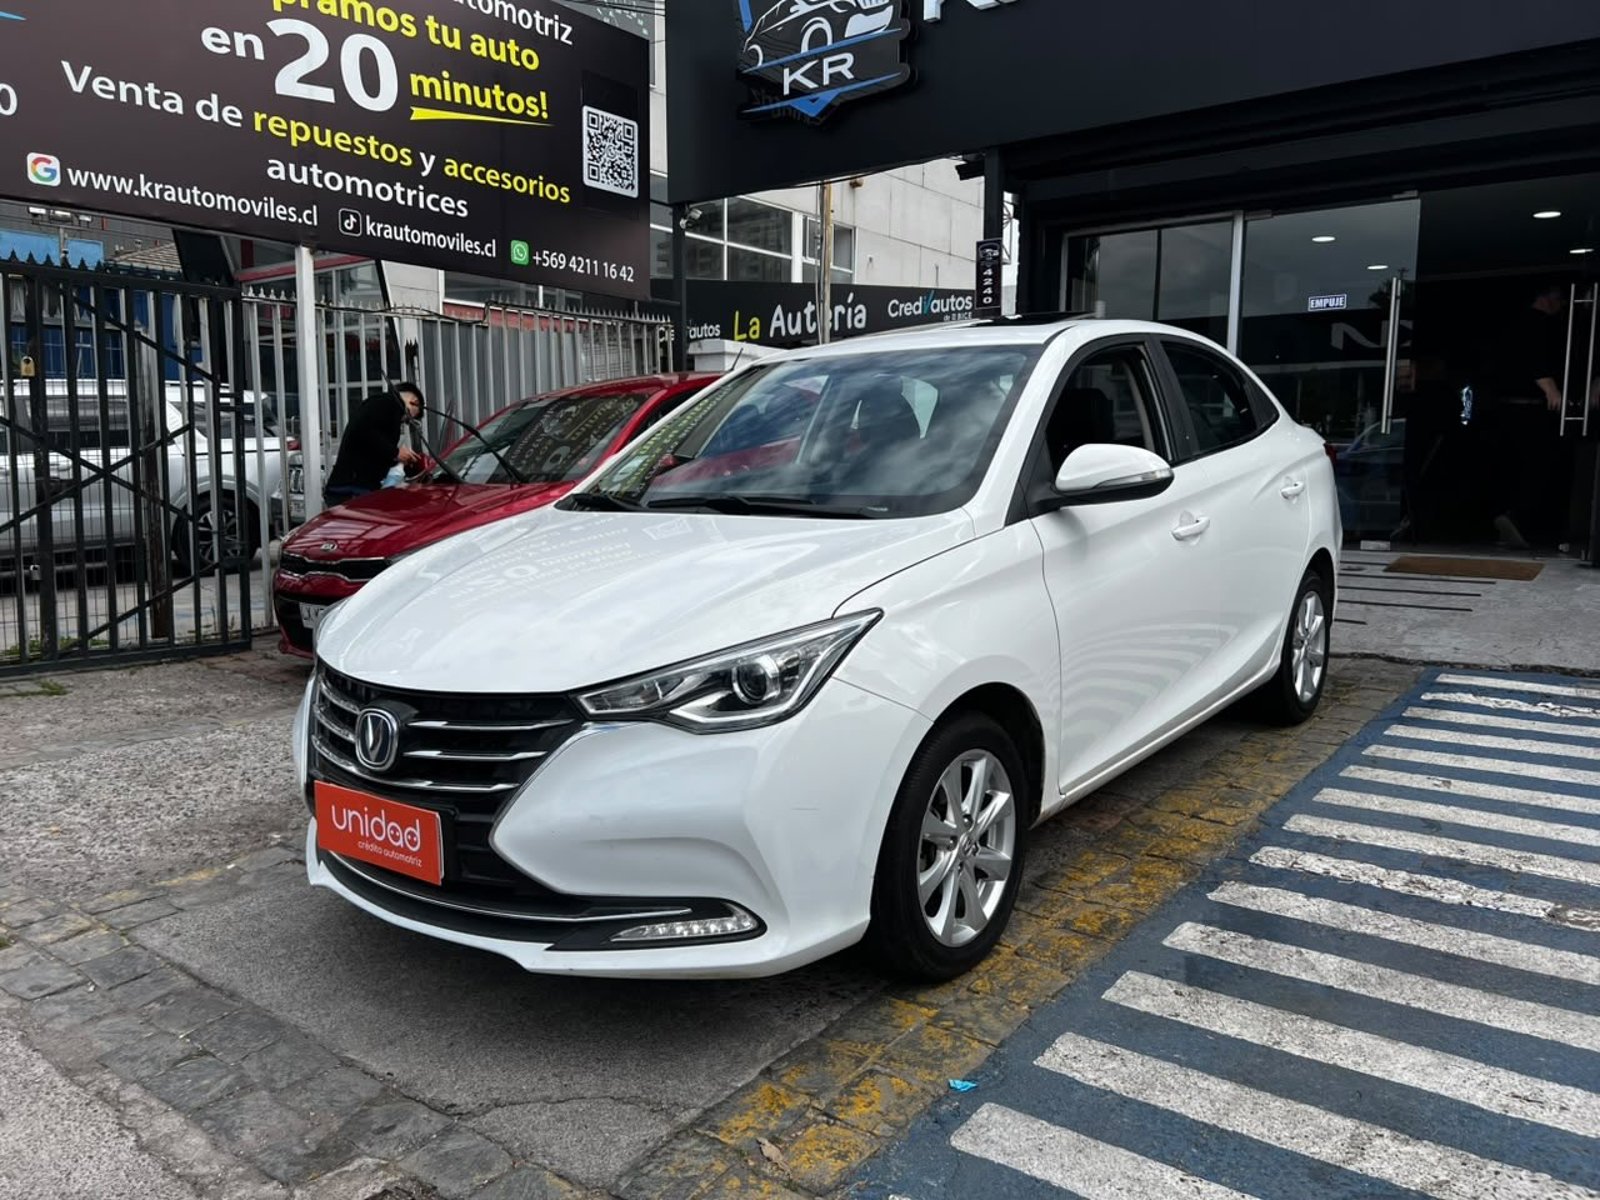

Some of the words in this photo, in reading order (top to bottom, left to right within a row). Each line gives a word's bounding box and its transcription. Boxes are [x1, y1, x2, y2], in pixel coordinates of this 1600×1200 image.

[425, 15, 461, 50] tu
[470, 33, 540, 70] auto
[453, 0, 573, 45] omotriz
[201, 26, 265, 60] en
[266, 18, 399, 112] 20
[410, 71, 549, 119] minutos!
[783, 52, 855, 96] KR
[61, 60, 184, 115] Venta
[196, 94, 243, 127] de
[254, 111, 412, 167] repuestos
[420, 152, 436, 177] y
[444, 157, 570, 204] accesorios
[67, 168, 319, 226] www.krautomoviles.cl
[267, 159, 469, 218] automotrices
[366, 215, 496, 258] krautomoviles.cl
[533, 250, 567, 271] +569
[569, 256, 599, 277] 4211
[983, 268, 993, 304] 4240
[1310, 297, 1344, 308] EMPUJE
[734, 310, 760, 341] La
[331, 804, 421, 852] unidad
[357, 840, 382, 855] crédito
[383, 847, 422, 868] automotriz
